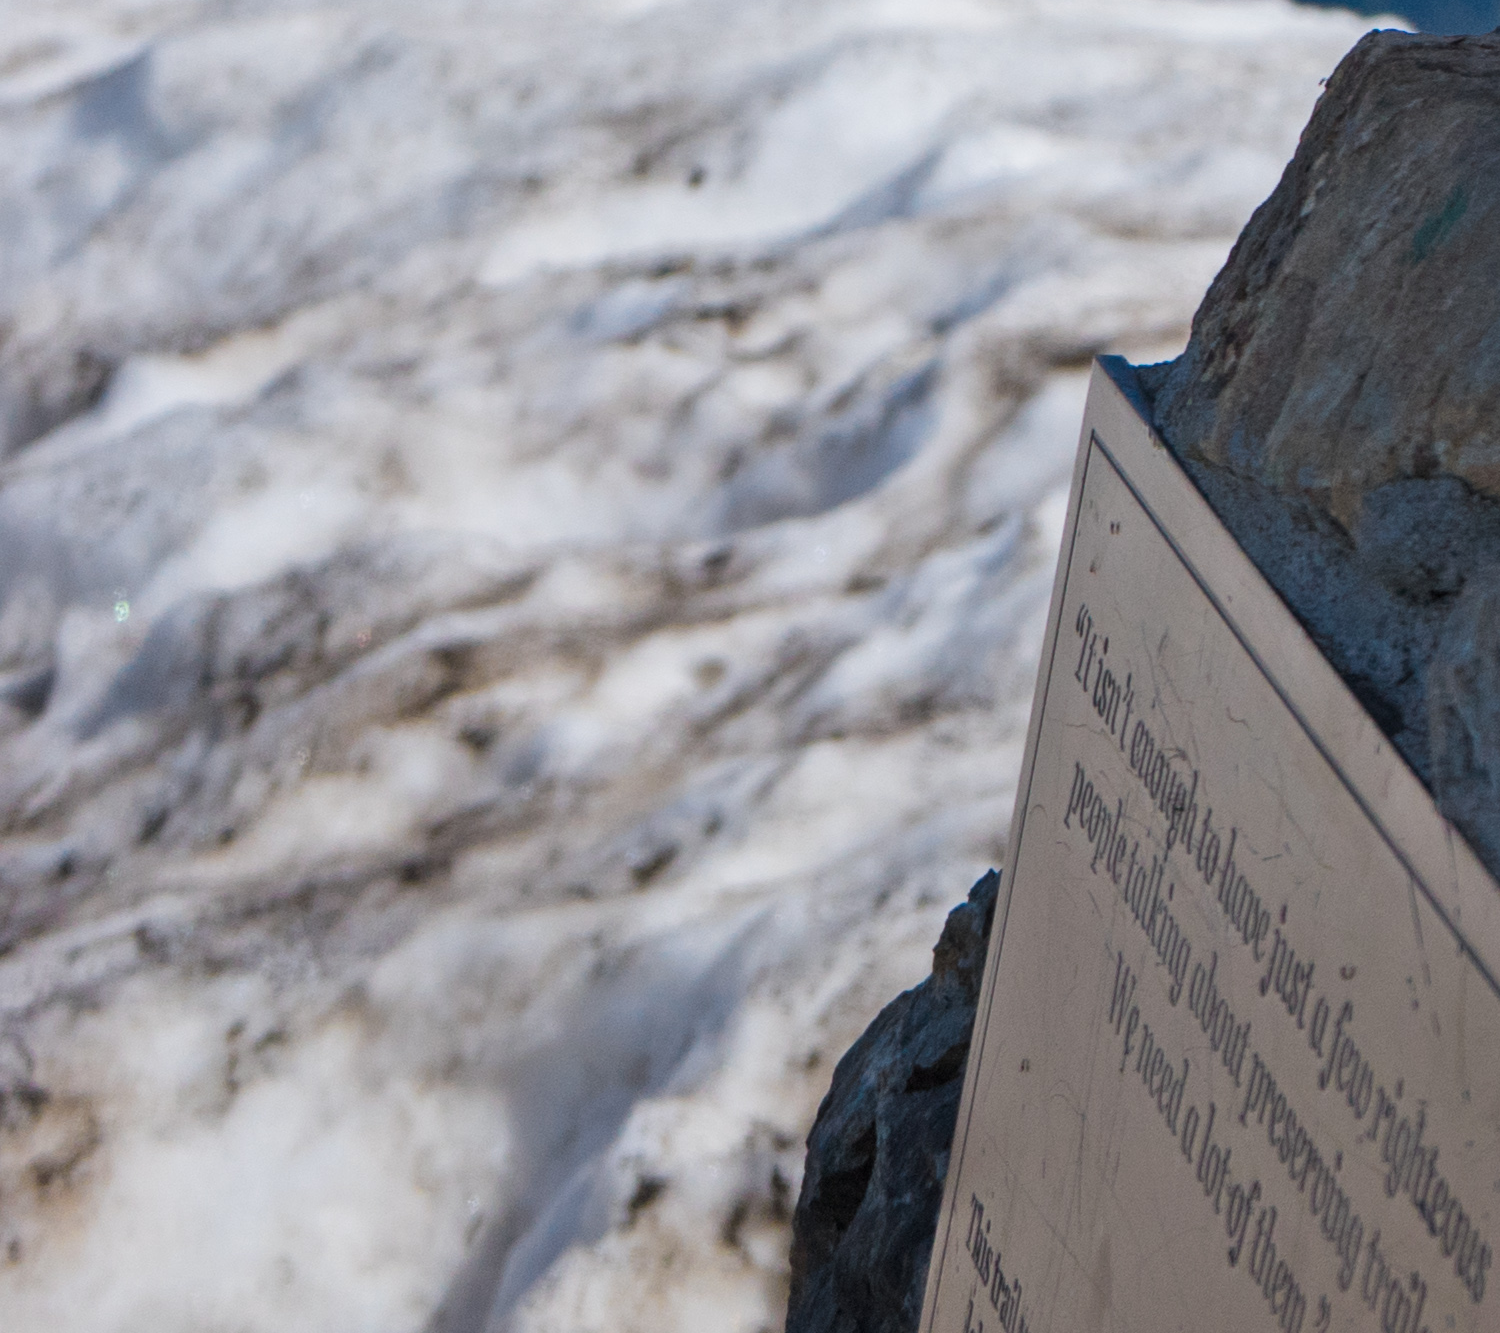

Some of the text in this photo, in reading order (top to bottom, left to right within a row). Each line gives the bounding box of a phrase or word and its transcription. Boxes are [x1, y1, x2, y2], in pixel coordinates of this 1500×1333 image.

[1130, 719, 1199, 857] enough
[1196, 807, 1221, 885] to
[1217, 826, 1271, 963] have
[1062, 759, 1128, 885] people
[1122, 840, 1192, 1008] talking
[1187, 950, 1252, 1089] about
[1237, 1051, 1365, 1294] preserving
[1258, 901, 1316, 1030] just
[1308, 996, 1329, 1059] a
[1108, 950, 1141, 1056] We
[1136, 1023, 1190, 1137] need
[1181, 1105, 1200, 1164] a
[1197, 1100, 1232, 1216] lot
[1225, 1179, 1262, 1268] of
[1317, 1000, 1375, 1121] few
[965, 1191, 995, 1288] This
